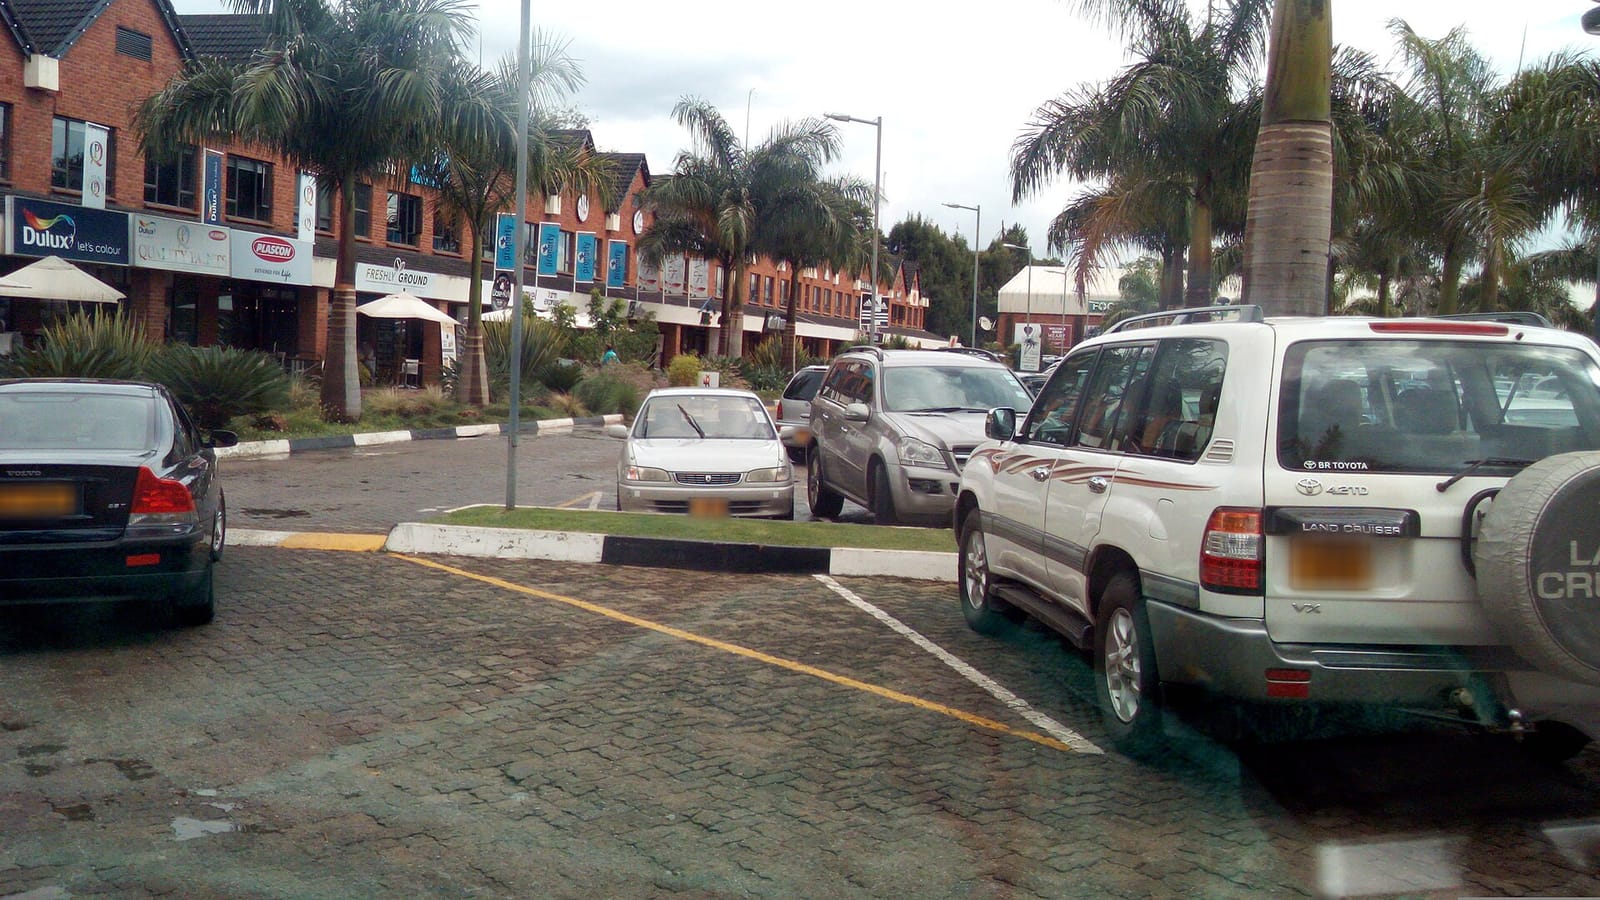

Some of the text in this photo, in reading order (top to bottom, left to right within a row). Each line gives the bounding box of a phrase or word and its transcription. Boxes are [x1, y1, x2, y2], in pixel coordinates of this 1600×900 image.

[23, 226, 70, 249] Dulux
[77, 241, 121, 255] let's colour
[256, 243, 292, 257] PLASCON
[366, 268, 428, 286] FRESHLY GROUND
[1318, 461, 1368, 470] BR TOYOTA
[1302, 523, 1401, 535] LAND CRUISER
[1291, 602, 1321, 614] VX
